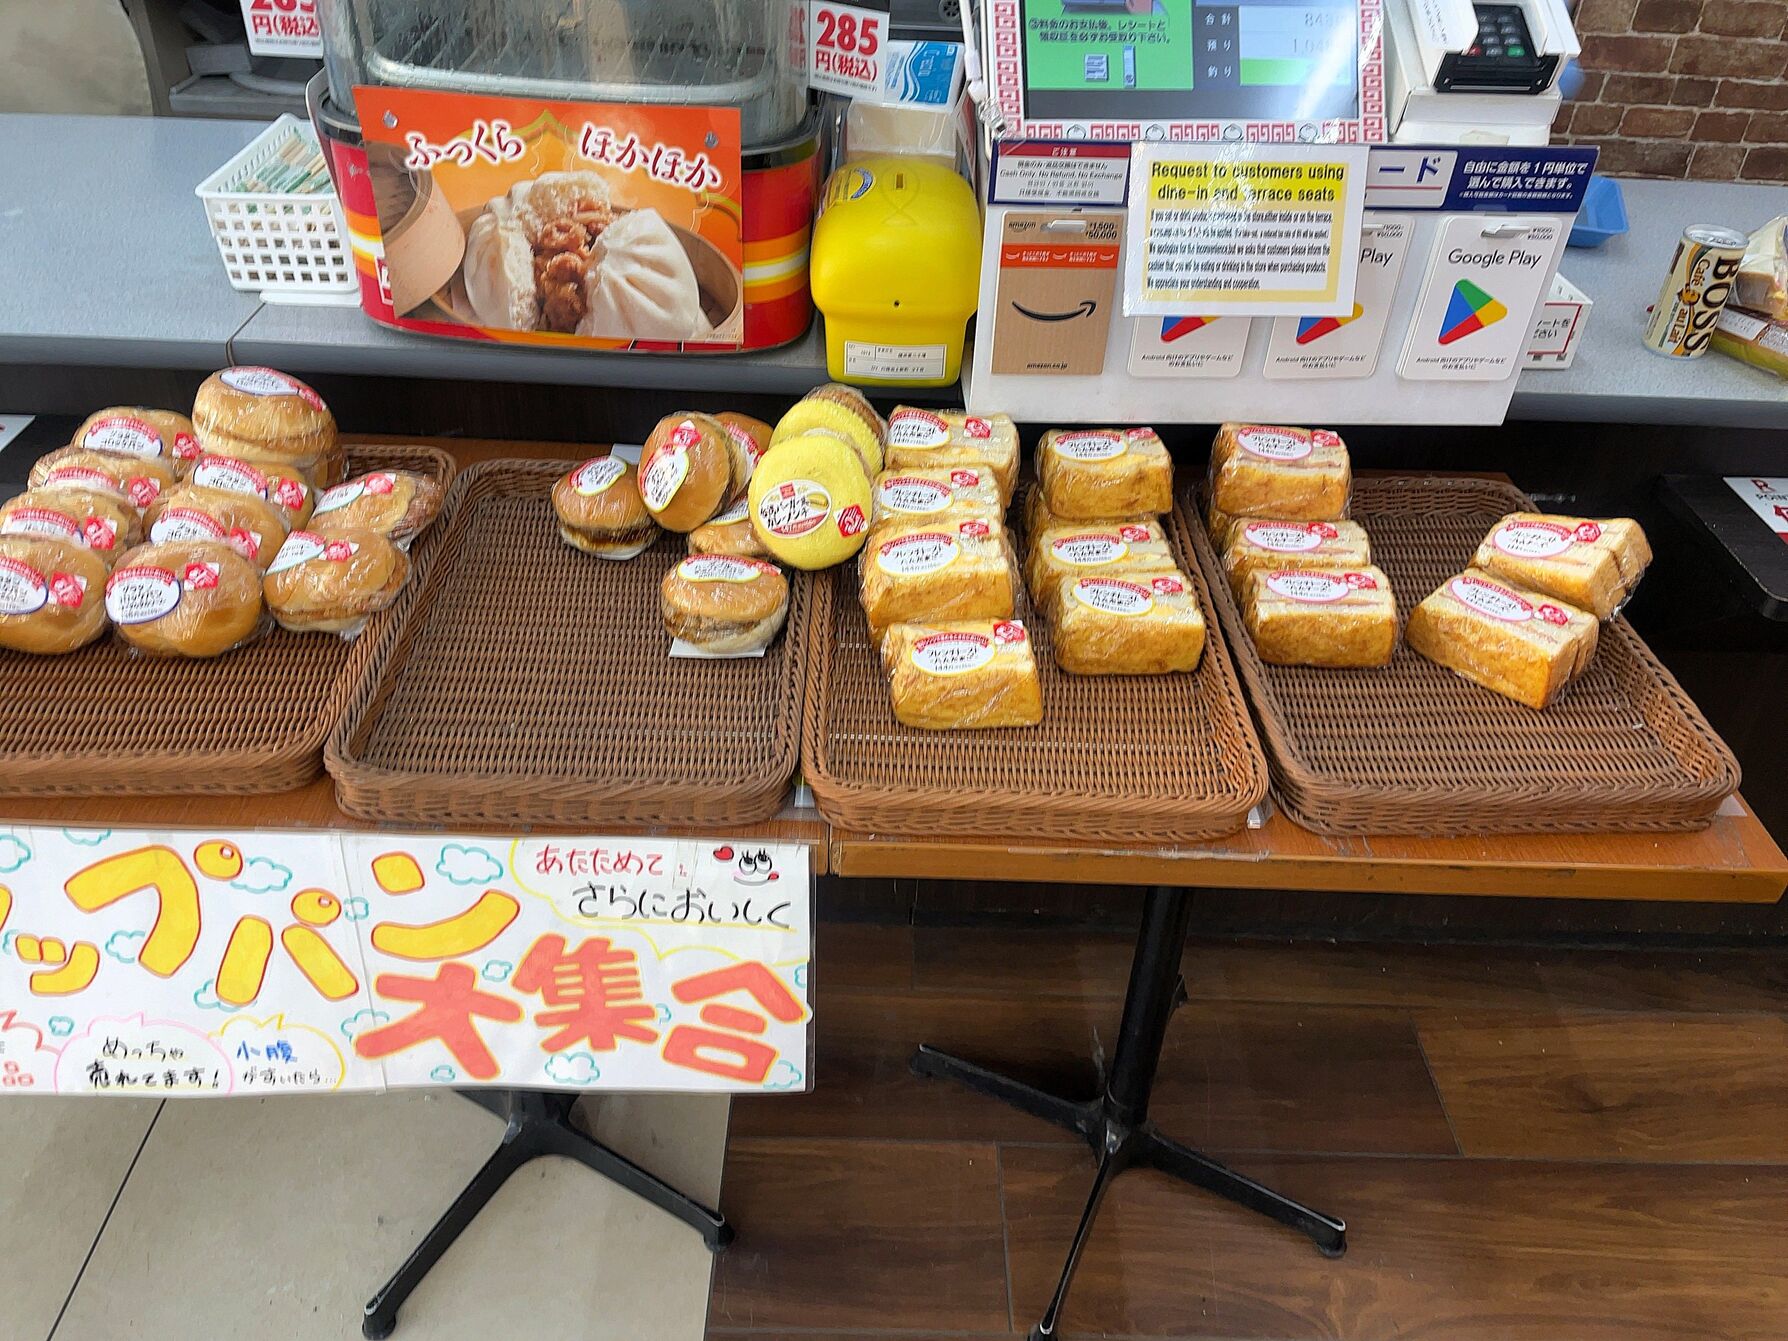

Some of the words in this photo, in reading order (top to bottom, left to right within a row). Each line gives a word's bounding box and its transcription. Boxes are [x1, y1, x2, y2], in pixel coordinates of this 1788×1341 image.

[816, 9, 879, 57] 285
[815, 50, 878, 83] 円(税込)
[405, 119, 526, 169] ふっくら
[579, 123, 722, 190] ほかほか
[1151, 161, 1208, 179] Request
[1213, 163, 1227, 178] to
[1232, 163, 1303, 179] customers
[1309, 164, 1345, 181] using
[1157, 183, 1208, 200] dine-in
[1242, 185, 1293, 201] errace
[1298, 186, 1336, 201] seats
[1360, 248, 1394, 269] Play
[1448, 248, 1505, 268] Google
[1508, 249, 1542, 270] Play
[1691, 259, 1711, 287] Café
[1684, 256, 1742, 352] BOSS
[535, 844, 664, 877] あたためて
[572, 881, 792, 929] さらにおいしく
[0, 838, 521, 1007] ップパン
[355, 933, 806, 1084] 大集合
[102, 1036, 185, 1062] めっちゃ
[236, 1040, 298, 1064] 小腹
